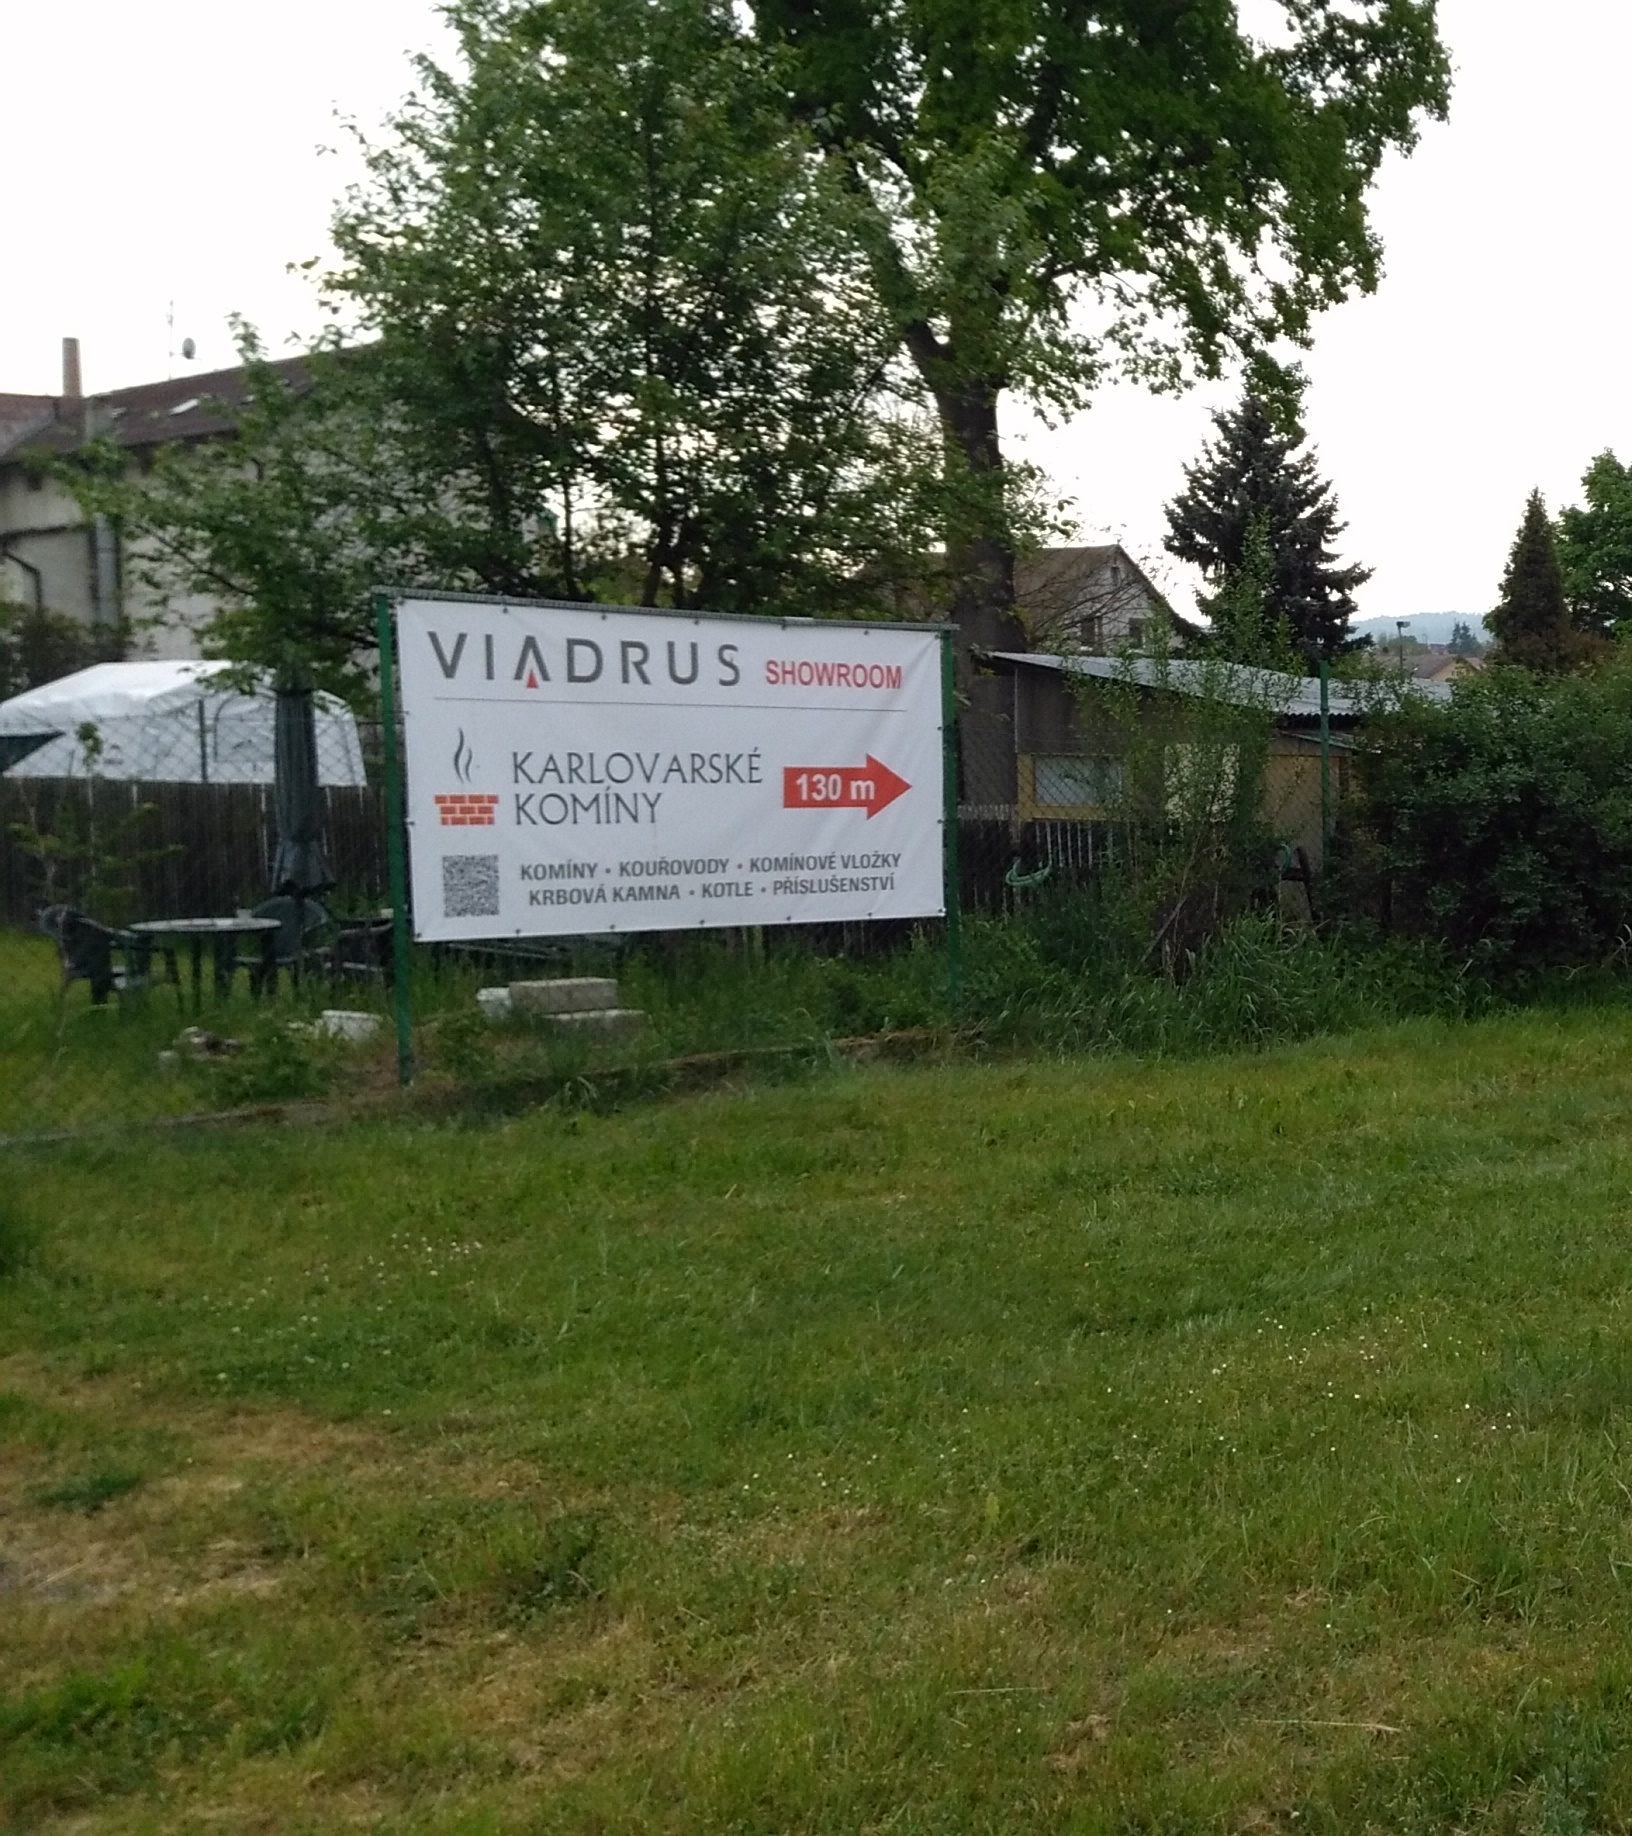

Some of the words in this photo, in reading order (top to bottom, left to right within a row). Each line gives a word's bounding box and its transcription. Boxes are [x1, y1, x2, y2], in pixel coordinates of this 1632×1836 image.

[427, 631, 740, 689] VIADRUS
[766, 660, 902, 689] SHOWROOM
[512, 747, 763, 784] KARLOVARSKÉ
[796, 773, 842, 801] 130
[850, 779, 875, 800] m
[515, 786, 662, 825] KOMÍNY
[520, 859, 598, 881] KOMÍNY
[619, 856, 730, 878] KOUŘOVODY
[750, 851, 837, 874] KOMÍNOVÉ
[841, 850, 902, 870] VLOŽKY
[529, 884, 607, 906] KRBOVÁ
[612, 884, 681, 903] KAMNA
[701, 881, 754, 898] KOTLE
[772, 872, 895, 895] PŘÍSLUŠENSTVÍ
